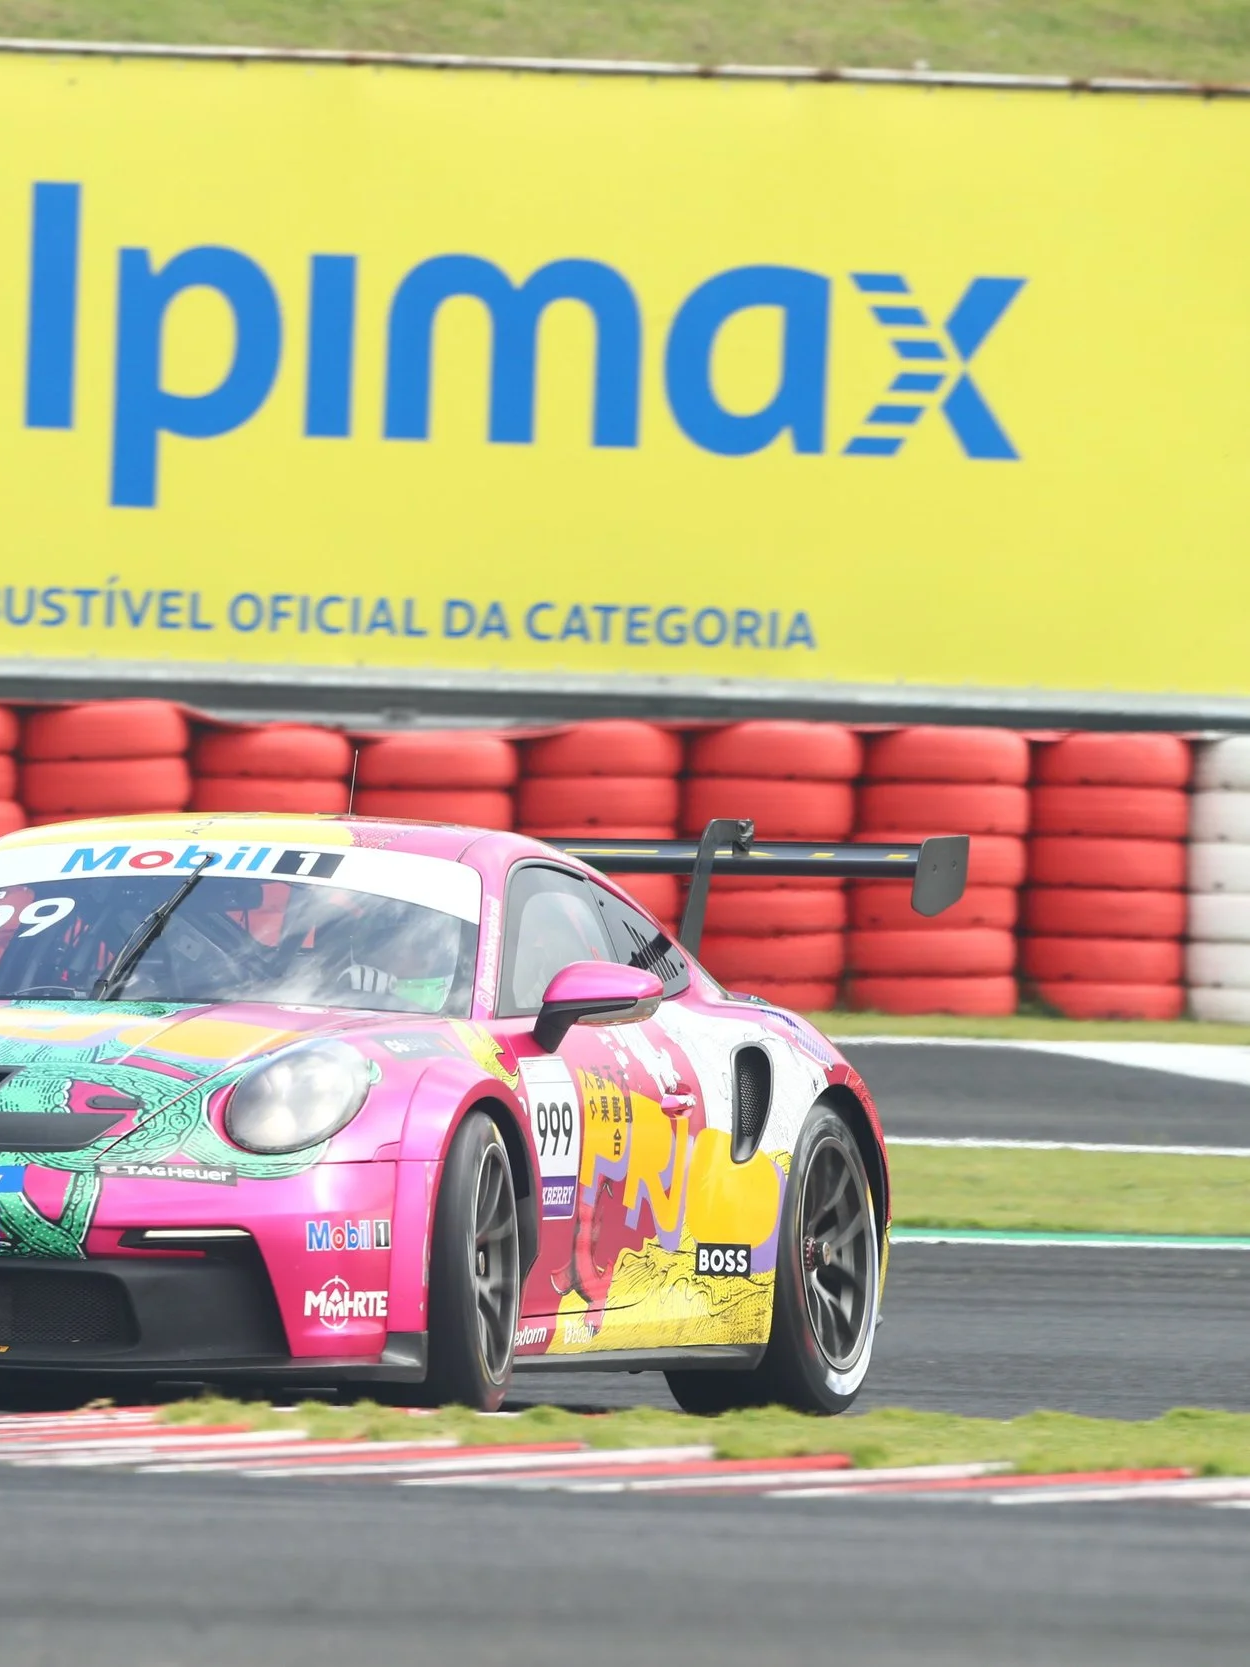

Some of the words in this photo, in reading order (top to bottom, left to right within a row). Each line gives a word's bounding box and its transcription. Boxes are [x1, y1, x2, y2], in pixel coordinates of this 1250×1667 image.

[22, 179, 1030, 510] Ipimax
[227, 591, 429, 638] OFICIAL
[441, 599, 512, 642] DA
[523, 601, 817, 650] CATEGORIA
[60, 844, 272, 873] Mobil
[536, 1101, 573, 1157] 999
[306, 1220, 371, 1251] Mobil
[698, 1248, 748, 1273] BOSS
